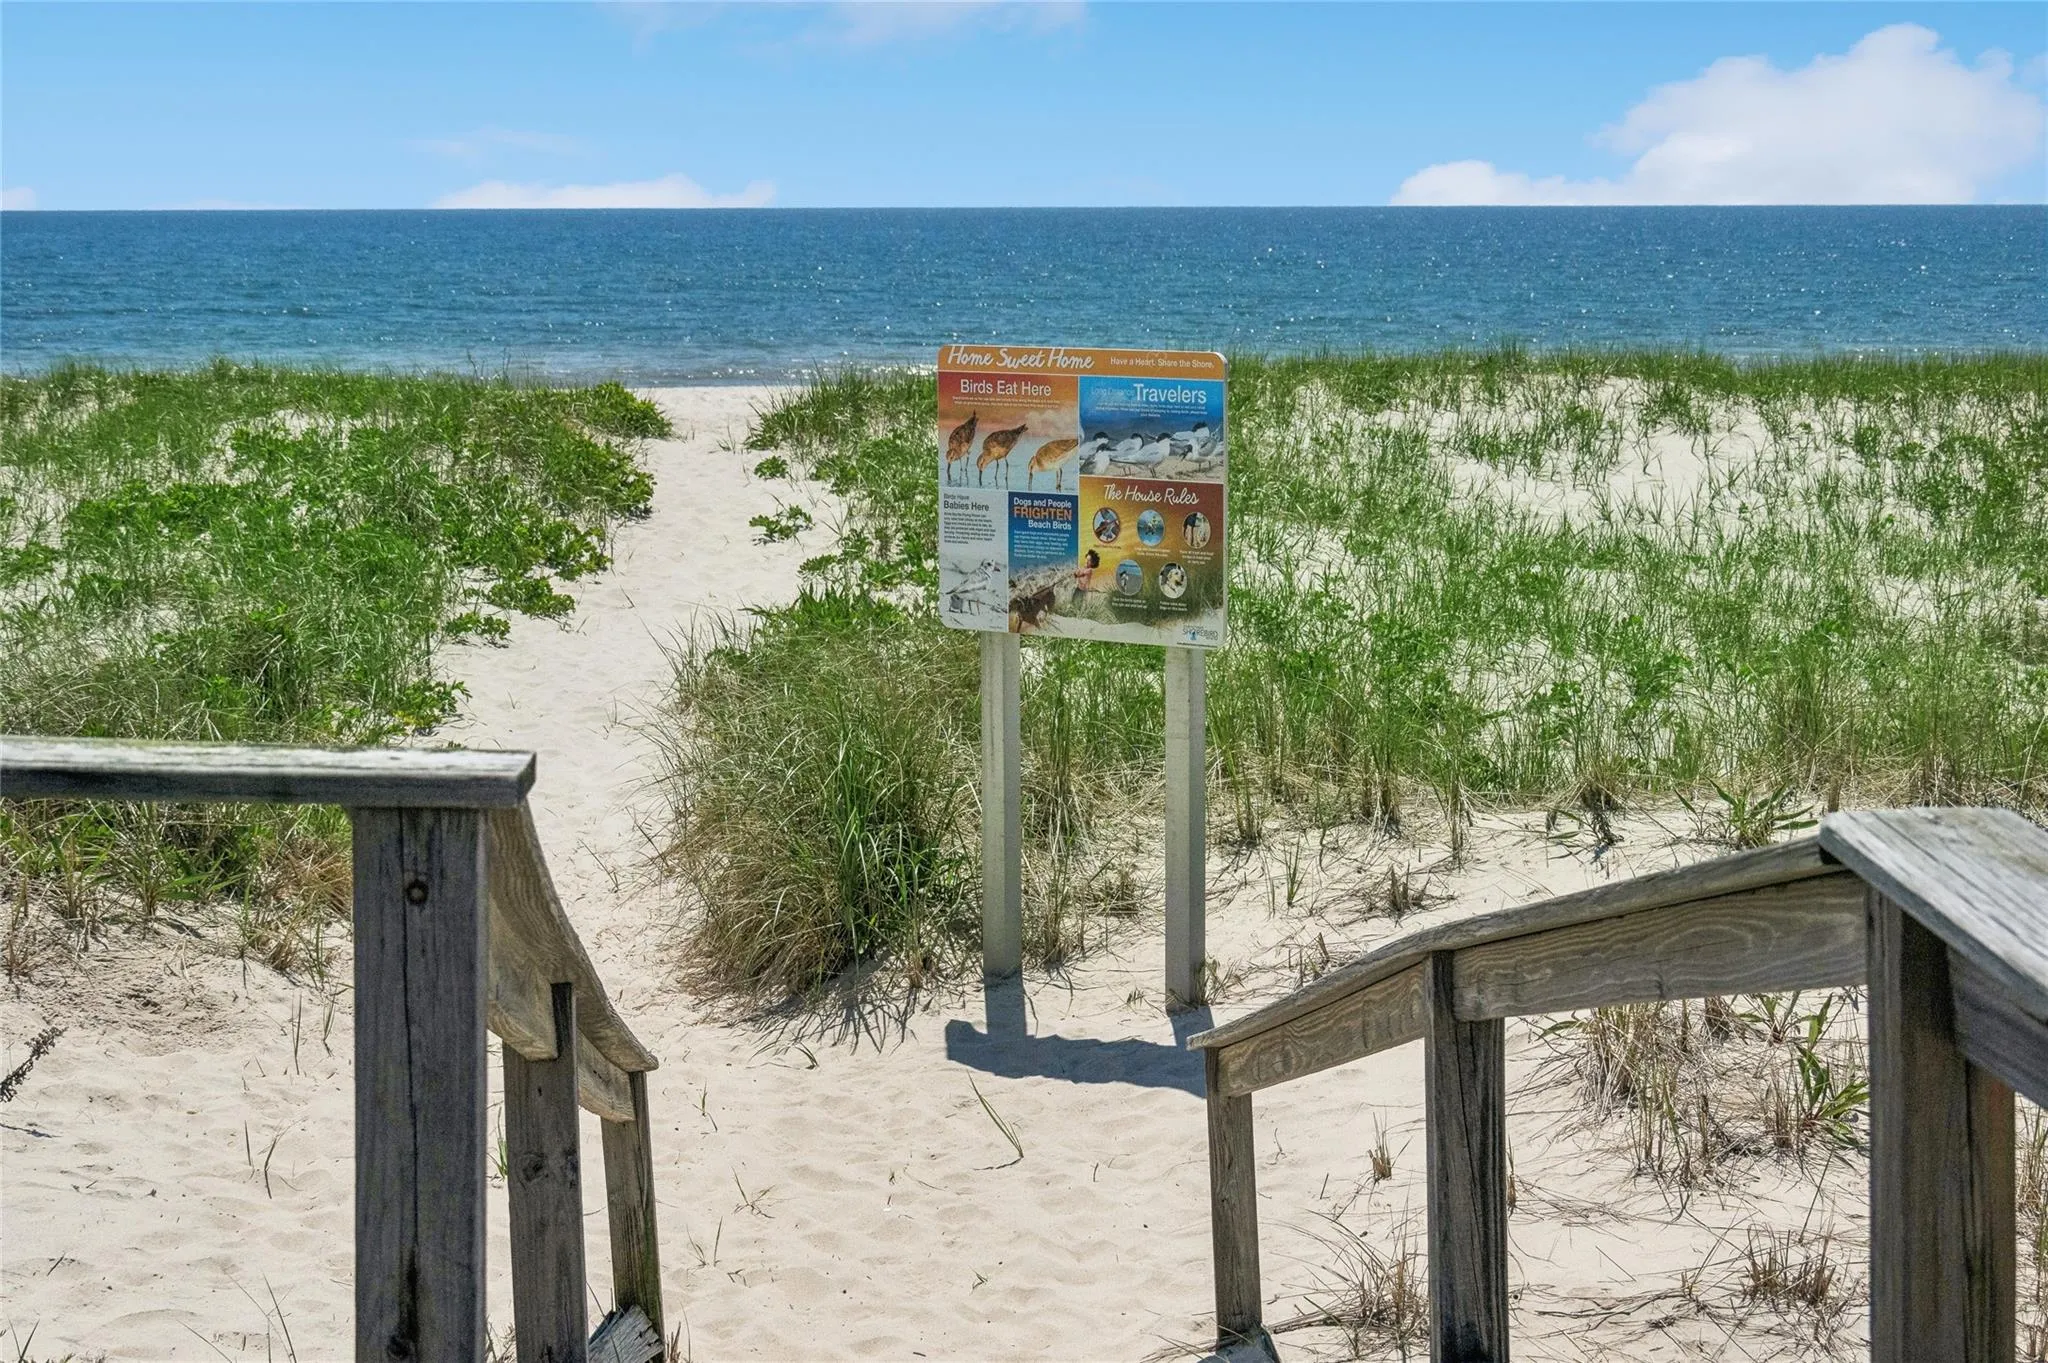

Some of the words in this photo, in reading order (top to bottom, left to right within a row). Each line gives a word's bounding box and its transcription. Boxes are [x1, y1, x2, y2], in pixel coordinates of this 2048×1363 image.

[947, 345, 994, 365] Home
[996, 348, 1046, 369] Sweet
[1047, 348, 1095, 369] Home
[1110, 357, 1128, 366] Have
[1157, 358, 1178, 367] Share
[1179, 359, 1190, 368] the
[960, 379, 994, 394] Birds
[997, 380, 1018, 395] Eat
[1021, 381, 1052, 397] Here
[1133, 383, 1207, 404] Travelers
[1104, 483, 1122, 501] The
[1124, 485, 1162, 502] House
[1163, 487, 1200, 505] Rules
[943, 500, 970, 511] Babies
[971, 501, 990, 512] Here
[1013, 497, 1032, 508] Dogs
[1033, 498, 1046, 507] and
[1047, 499, 1072, 509] People
[1013, 506, 1072, 521] FRIGHTEN
[1028, 519, 1051, 529] Beach
[1052, 521, 1072, 531] Birds
